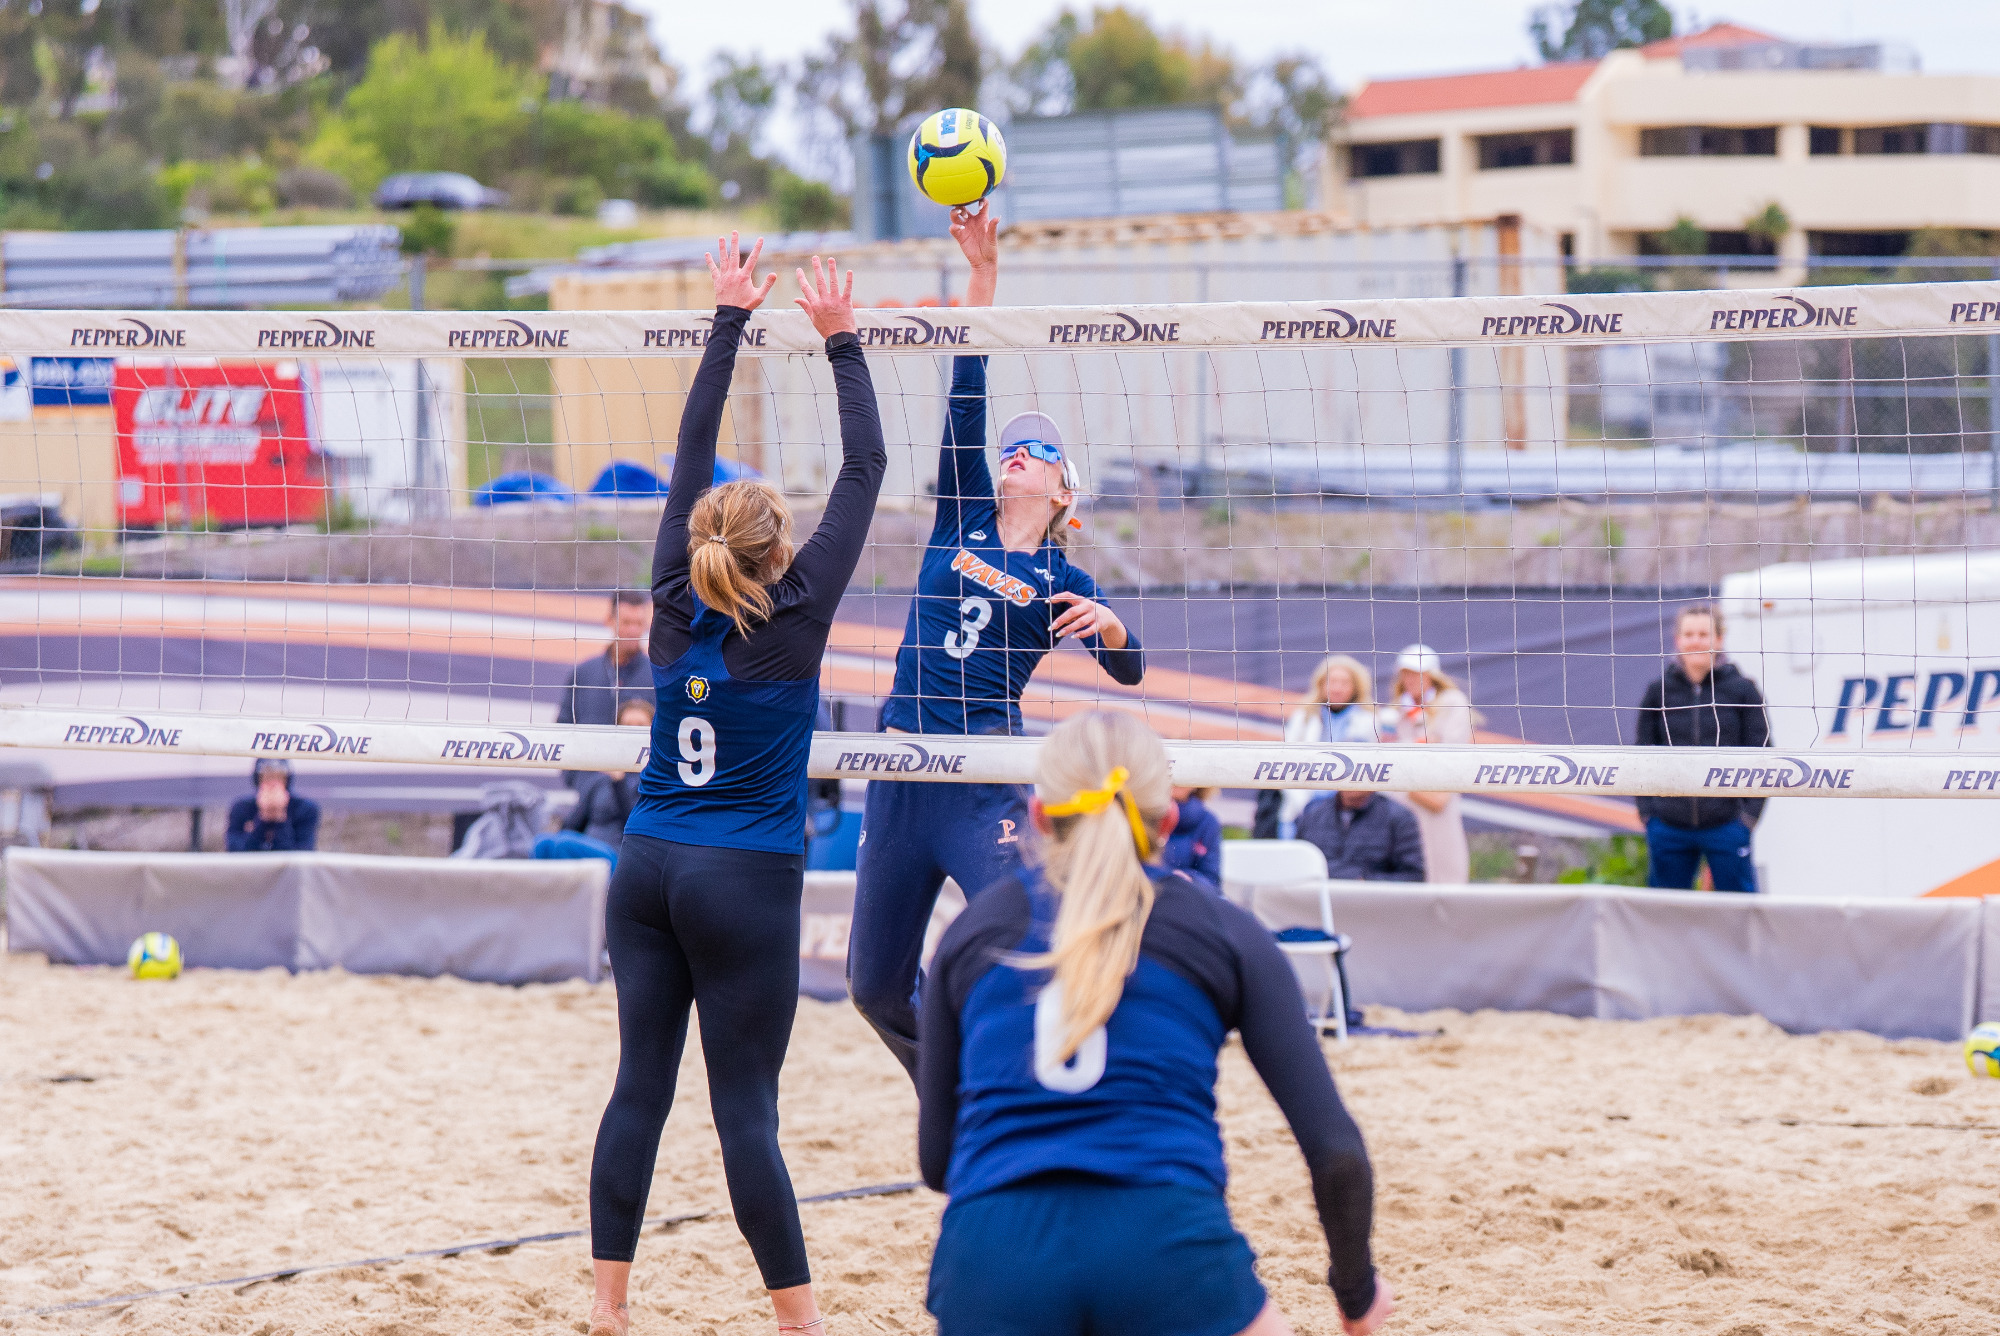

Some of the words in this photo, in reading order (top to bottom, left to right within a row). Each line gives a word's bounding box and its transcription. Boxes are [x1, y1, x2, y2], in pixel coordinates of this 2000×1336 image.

[1049, 312, 1180, 343] PEPPERDINE
[1260, 308, 1397, 339] PEPPERDINE
[1481, 303, 1623, 336] PEPPERDINE
[1710, 296, 1858, 329] PEPPERDINE
[71, 318, 187, 348] PEPPERDINE
[258, 318, 376, 349] PEPPERDINE
[449, 318, 570, 349] PEPPERDINE
[643, 317, 767, 347] PEPPENE
[857, 315, 971, 346] EPPERDINE
[951, 548, 1037, 607] WAVES
[944, 596, 992, 659] 3
[64, 716, 183, 747] PEPPERDINE
[251, 724, 372, 755] PEPPERDINE
[441, 731, 565, 762] PEPPERDINE
[678, 716, 716, 787] 9
[835, 743, 967, 774] PEPPERDINE
[1254, 751, 1394, 783] PEPPERDINE
[1474, 754, 1620, 786] PEPPERDINE
[1704, 757, 1855, 789] PEPPERDINE
